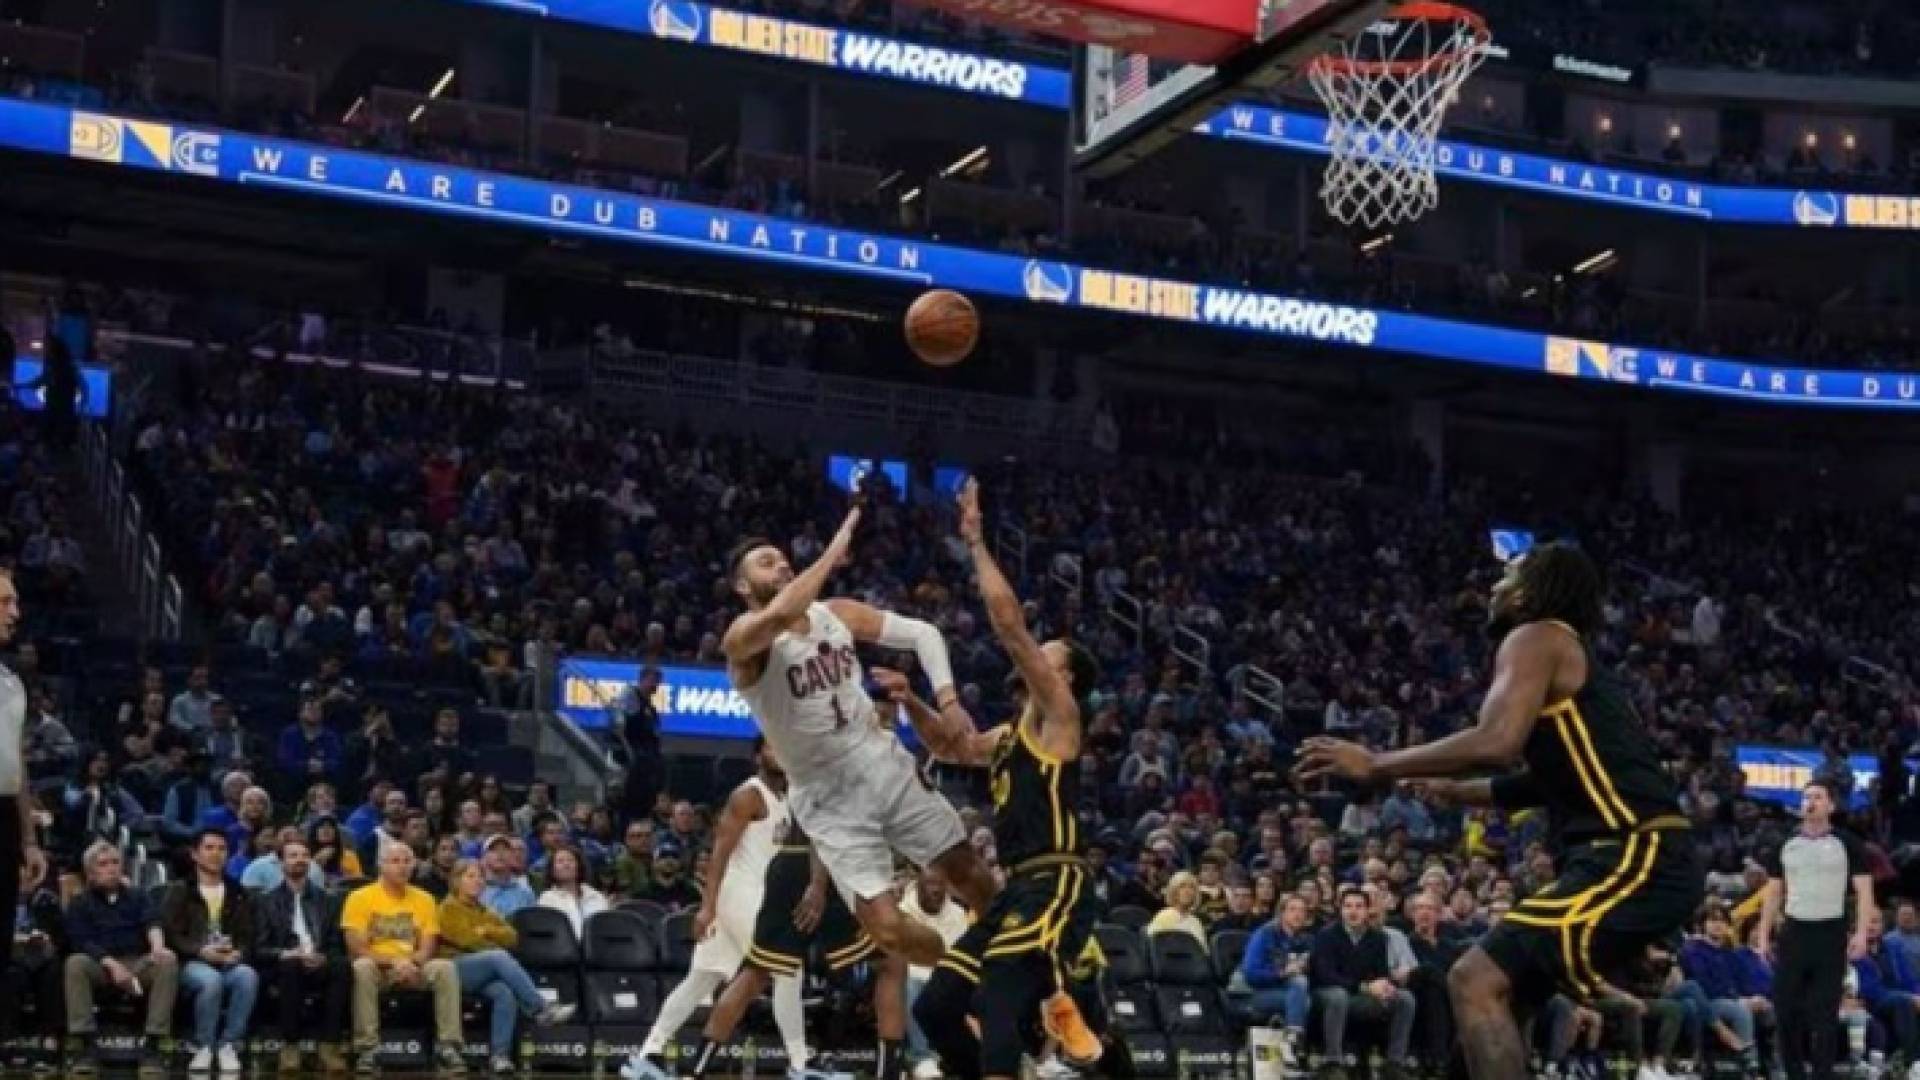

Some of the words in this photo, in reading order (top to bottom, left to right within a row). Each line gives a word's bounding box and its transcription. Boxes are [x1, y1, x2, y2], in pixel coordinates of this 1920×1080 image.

[842, 34, 1027, 98] WARRIORS
[1232, 107, 1284, 135] WE
[1439, 145, 1513, 176] DUB
[1550, 165, 1701, 206] NATION
[253, 147, 328, 180] WE
[386, 168, 495, 206] ARE
[551, 193, 657, 231] DUB
[711, 218, 919, 269] NATION
[1204, 288, 1378, 345] WARRIORS
[1657, 356, 1705, 382] WE
[1740, 369, 1819, 396] ARE
[1863, 377, 1916, 399] DU
[787, 645, 852, 698] CAVS
[677, 686, 749, 718] WAR
[831, 694, 848, 729] 1
